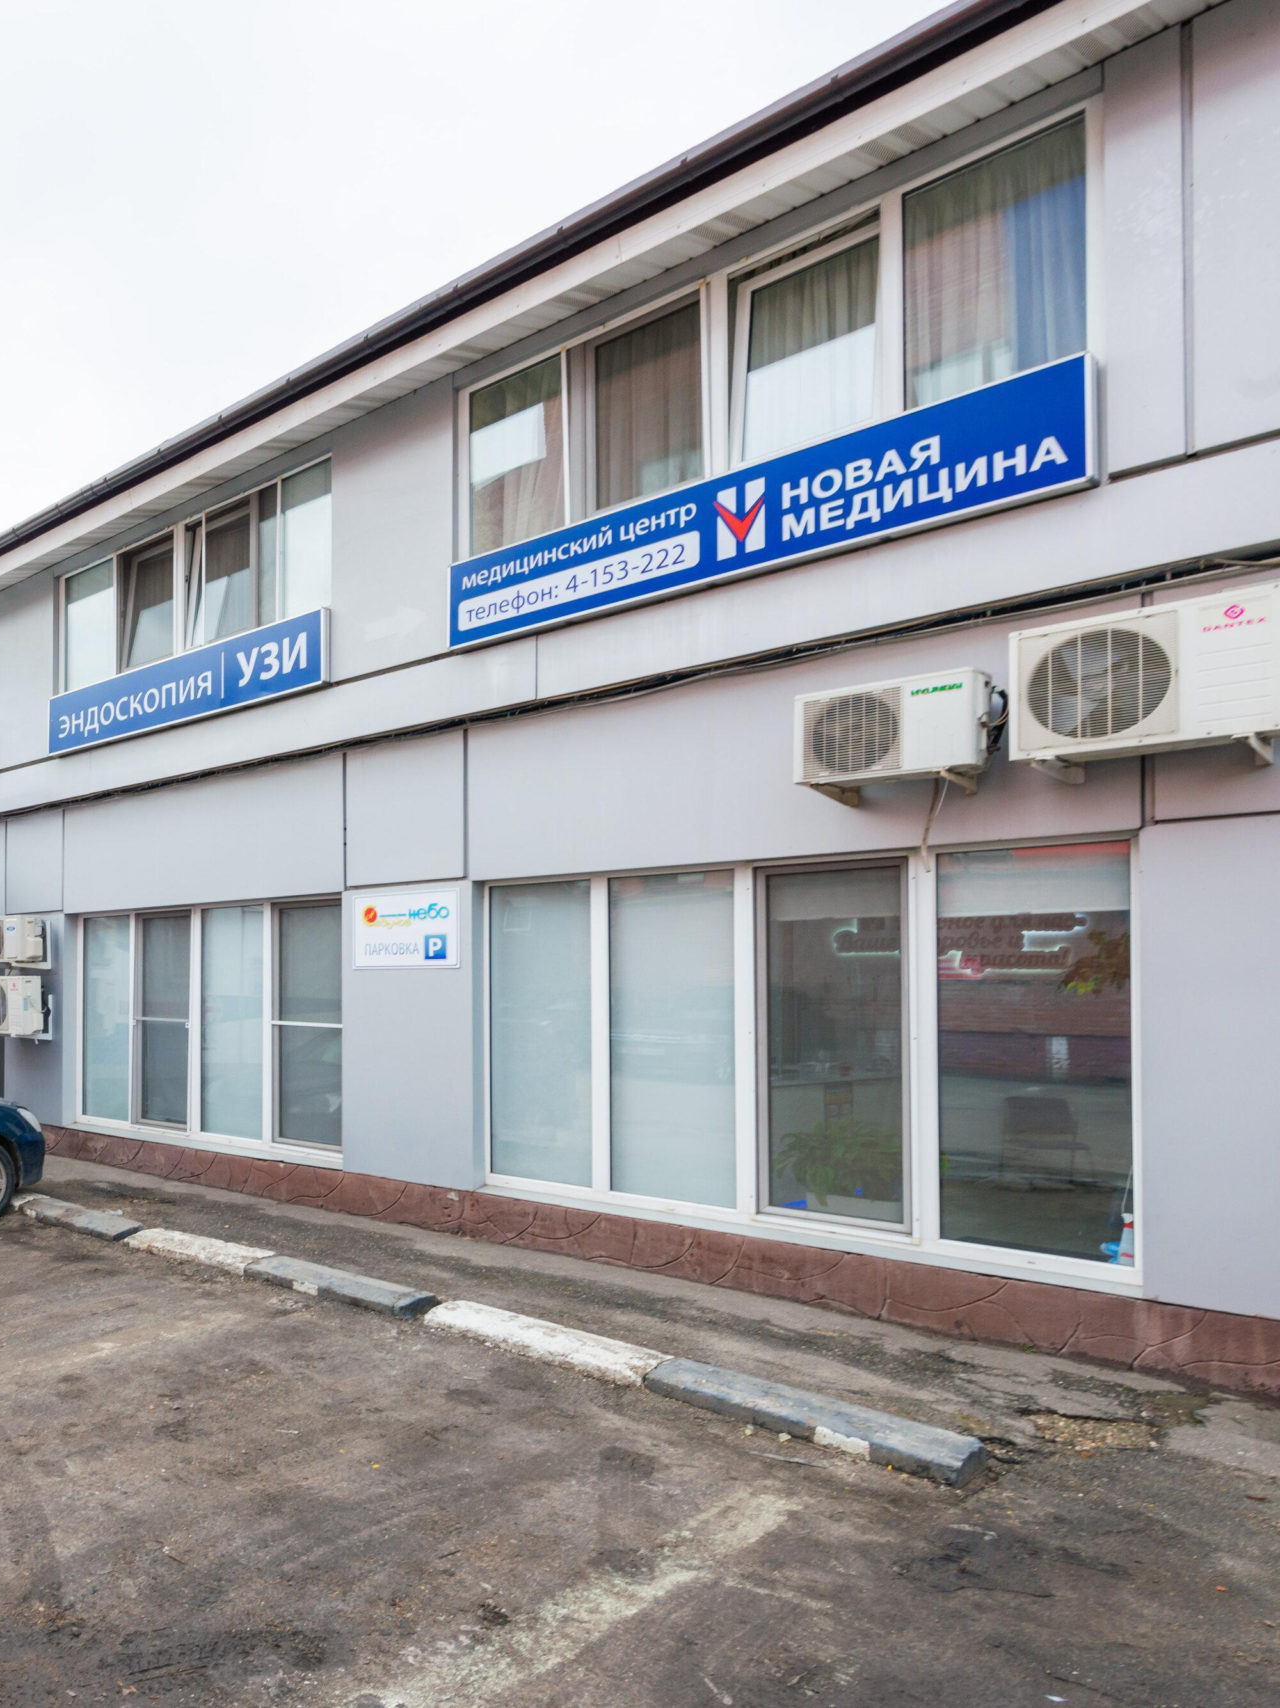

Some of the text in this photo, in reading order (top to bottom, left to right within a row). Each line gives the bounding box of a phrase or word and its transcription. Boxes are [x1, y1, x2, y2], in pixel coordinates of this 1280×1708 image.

[781, 434, 941, 510] НОВАЯ
[781, 435, 1069, 542] МЕДИЦИНА
[461, 502, 697, 591] медицинский центр
[466, 544, 686, 623] телефон: 4-153-222
[236, 631, 308, 687] УЗИ
[364, 942, 420, 956] ПАРКОВКА
[408, 902, 450, 920] небо
